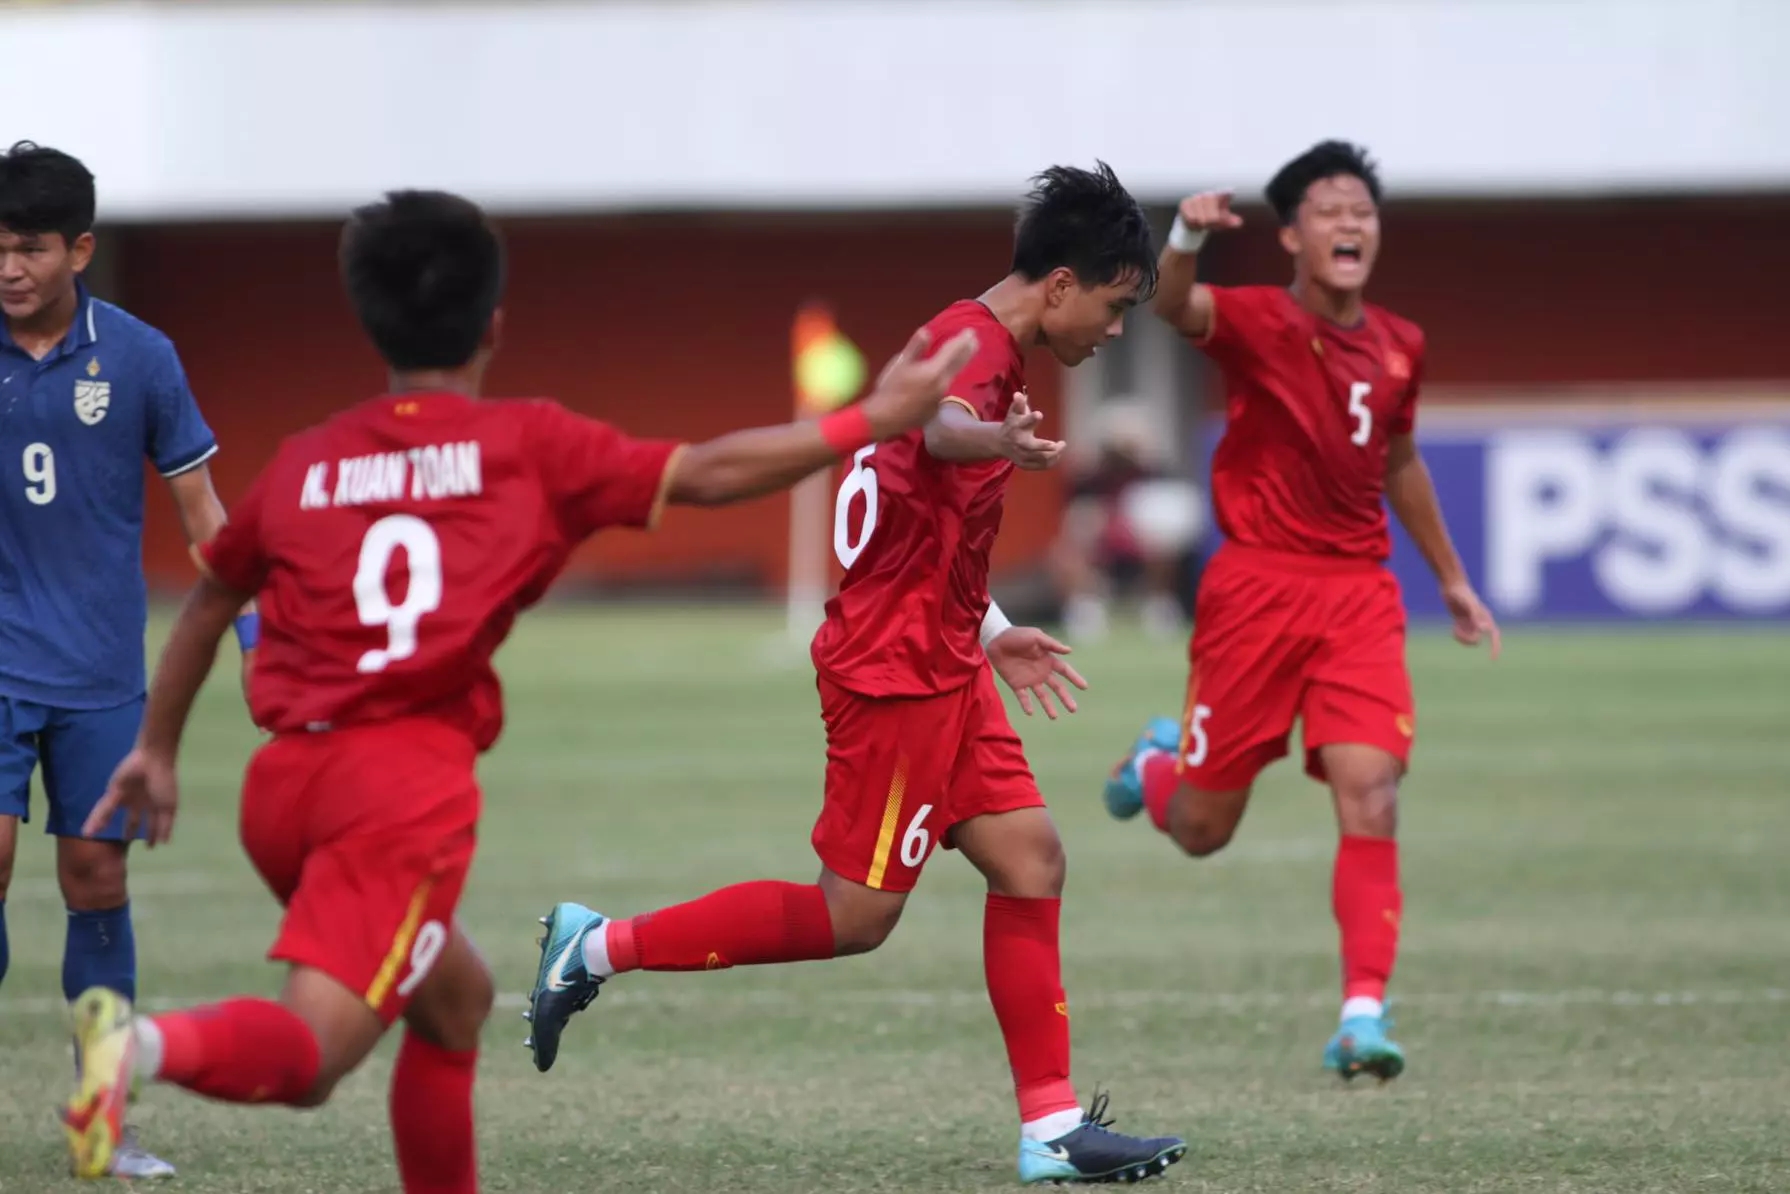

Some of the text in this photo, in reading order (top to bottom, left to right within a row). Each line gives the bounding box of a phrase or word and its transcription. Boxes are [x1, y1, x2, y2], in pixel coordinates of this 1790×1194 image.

[1349, 382, 1372, 446] 5
[22, 442, 57, 505] 9
[333, 451, 407, 506] XUAN
[408, 440, 483, 501] TOAN
[834, 443, 878, 569] 6
[352, 514, 442, 673] 9
[1186, 705, 1211, 766] 5
[900, 804, 932, 867] 6
[398, 920, 446, 996] 9
